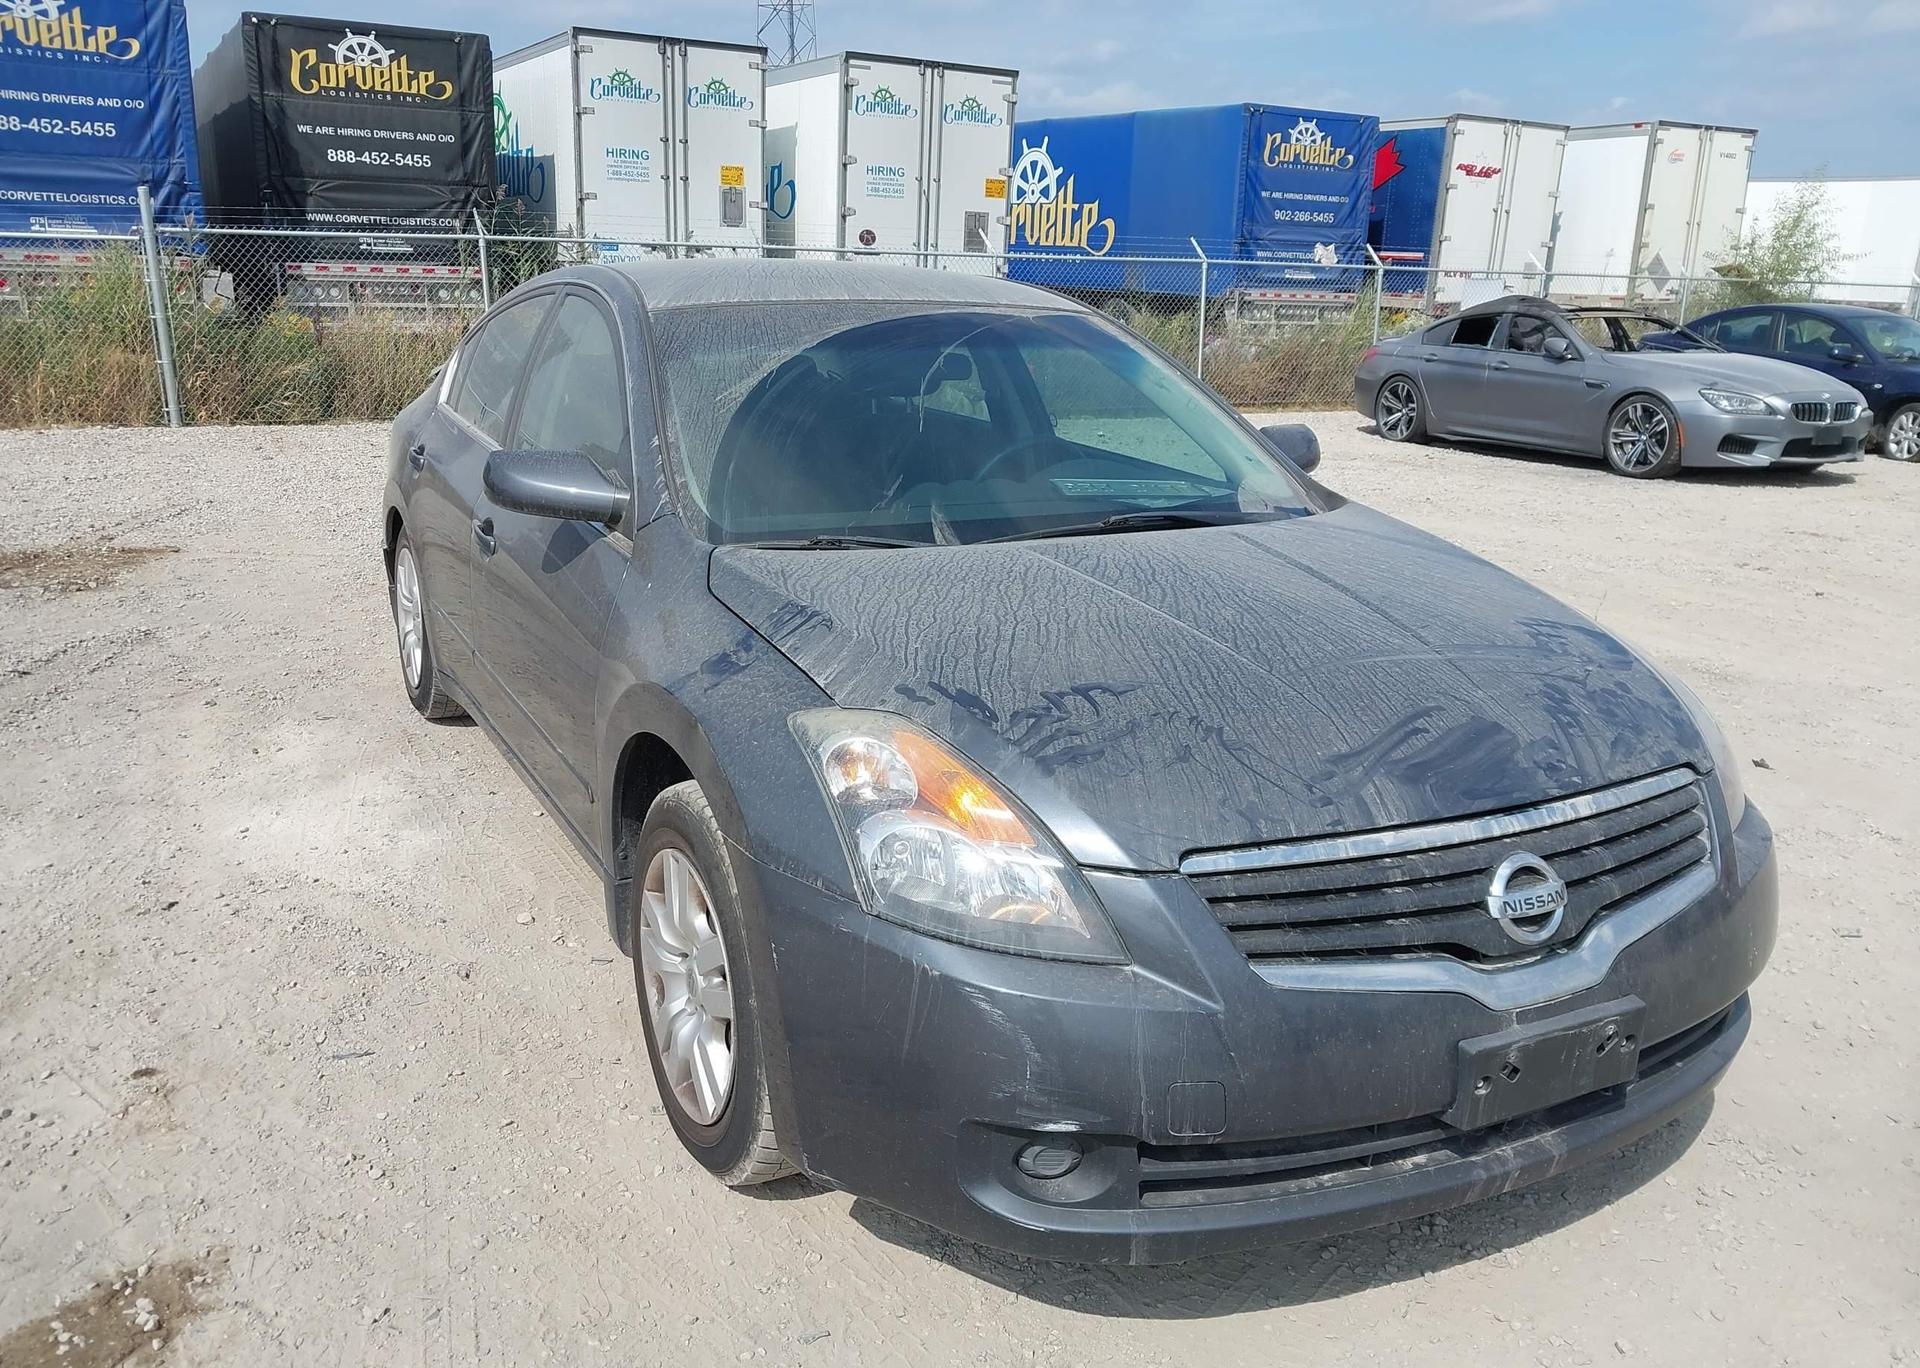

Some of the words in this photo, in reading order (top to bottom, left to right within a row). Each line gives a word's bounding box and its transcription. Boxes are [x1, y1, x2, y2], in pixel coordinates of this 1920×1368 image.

[75, 54, 109, 63] INC.
[290, 48, 453, 100] Corvette
[321, 89, 392, 101] LOGISTICS
[400, 96, 428, 104] INC.
[590, 77, 661, 103] Corvette
[687, 86, 754, 111] Corvette
[42, 92, 95, 106] DRIVERS
[97, 97, 121, 108] AND
[123, 99, 145, 109] O/O
[855, 94, 918, 119] Corvette
[943, 103, 1003, 128] Corvette
[297, 124, 313, 134] WE
[315, 126, 336, 135] ARE
[337, 127, 372, 138] HIRING
[374, 130, 414, 141] DRIVERS
[416, 133, 436, 142] AND
[438, 134, 455, 143] O/O
[327, 149, 432, 168] 888-452-5455
[606, 147, 650, 161] HIRING
[1264, 132, 1354, 170] Corvette
[866, 165, 905, 178] HIRING
[1271, 191, 1283, 199] ARE
[1283, 192, 1303, 200] HIRING
[1304, 193, 1328, 202] DRIVERS
[1328, 195, 1340, 203] AND
[306, 212, 460, 228] WWW.CORVETTELOGISTICS.COM
[1274, 209, 1335, 223] 902-266-5455
[1503, 889, 1565, 914] NISSAN
